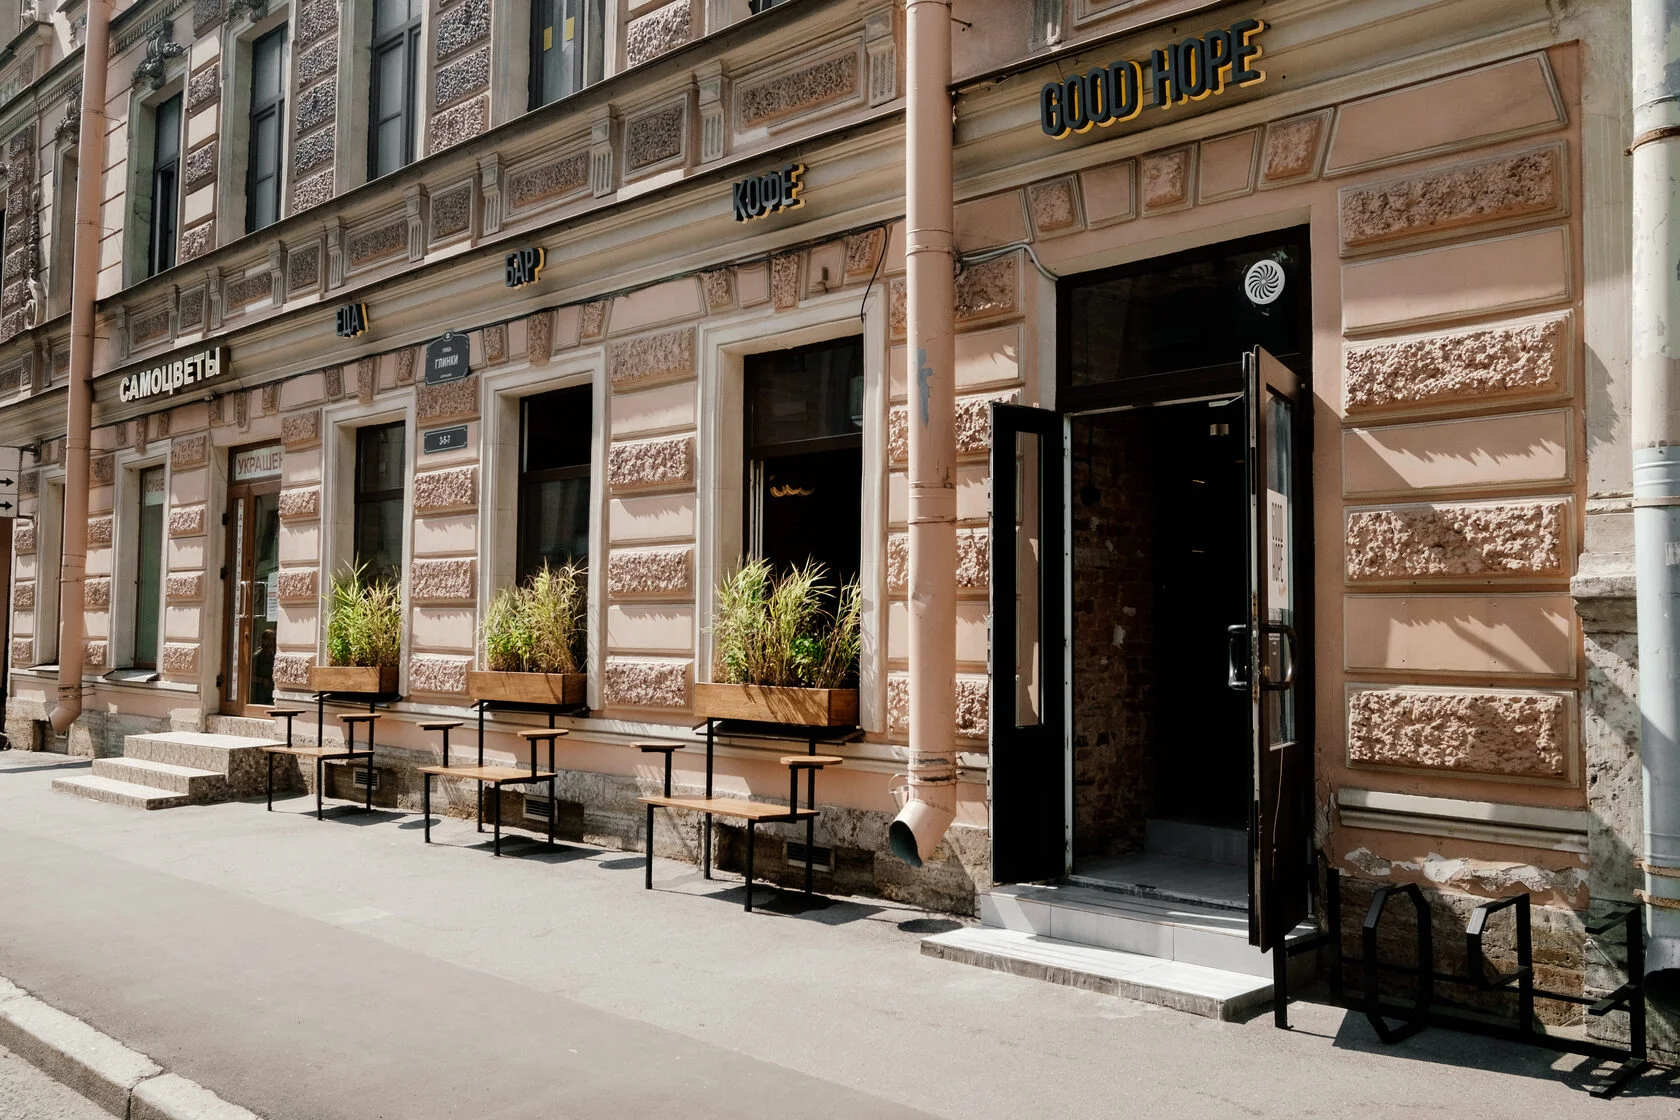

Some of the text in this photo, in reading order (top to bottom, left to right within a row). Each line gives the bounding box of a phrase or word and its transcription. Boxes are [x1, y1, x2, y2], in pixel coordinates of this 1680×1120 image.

[1040, 19, 1266, 140] GOOD HOPE
[732, 163, 805, 223] КОФЕ
[505, 247, 542, 289] БАР
[336, 303, 365, 337] ЕДА
[120, 347, 220, 402] САМОЦВЕТЫ
[434, 354, 459, 369] ГЛИНКИ
